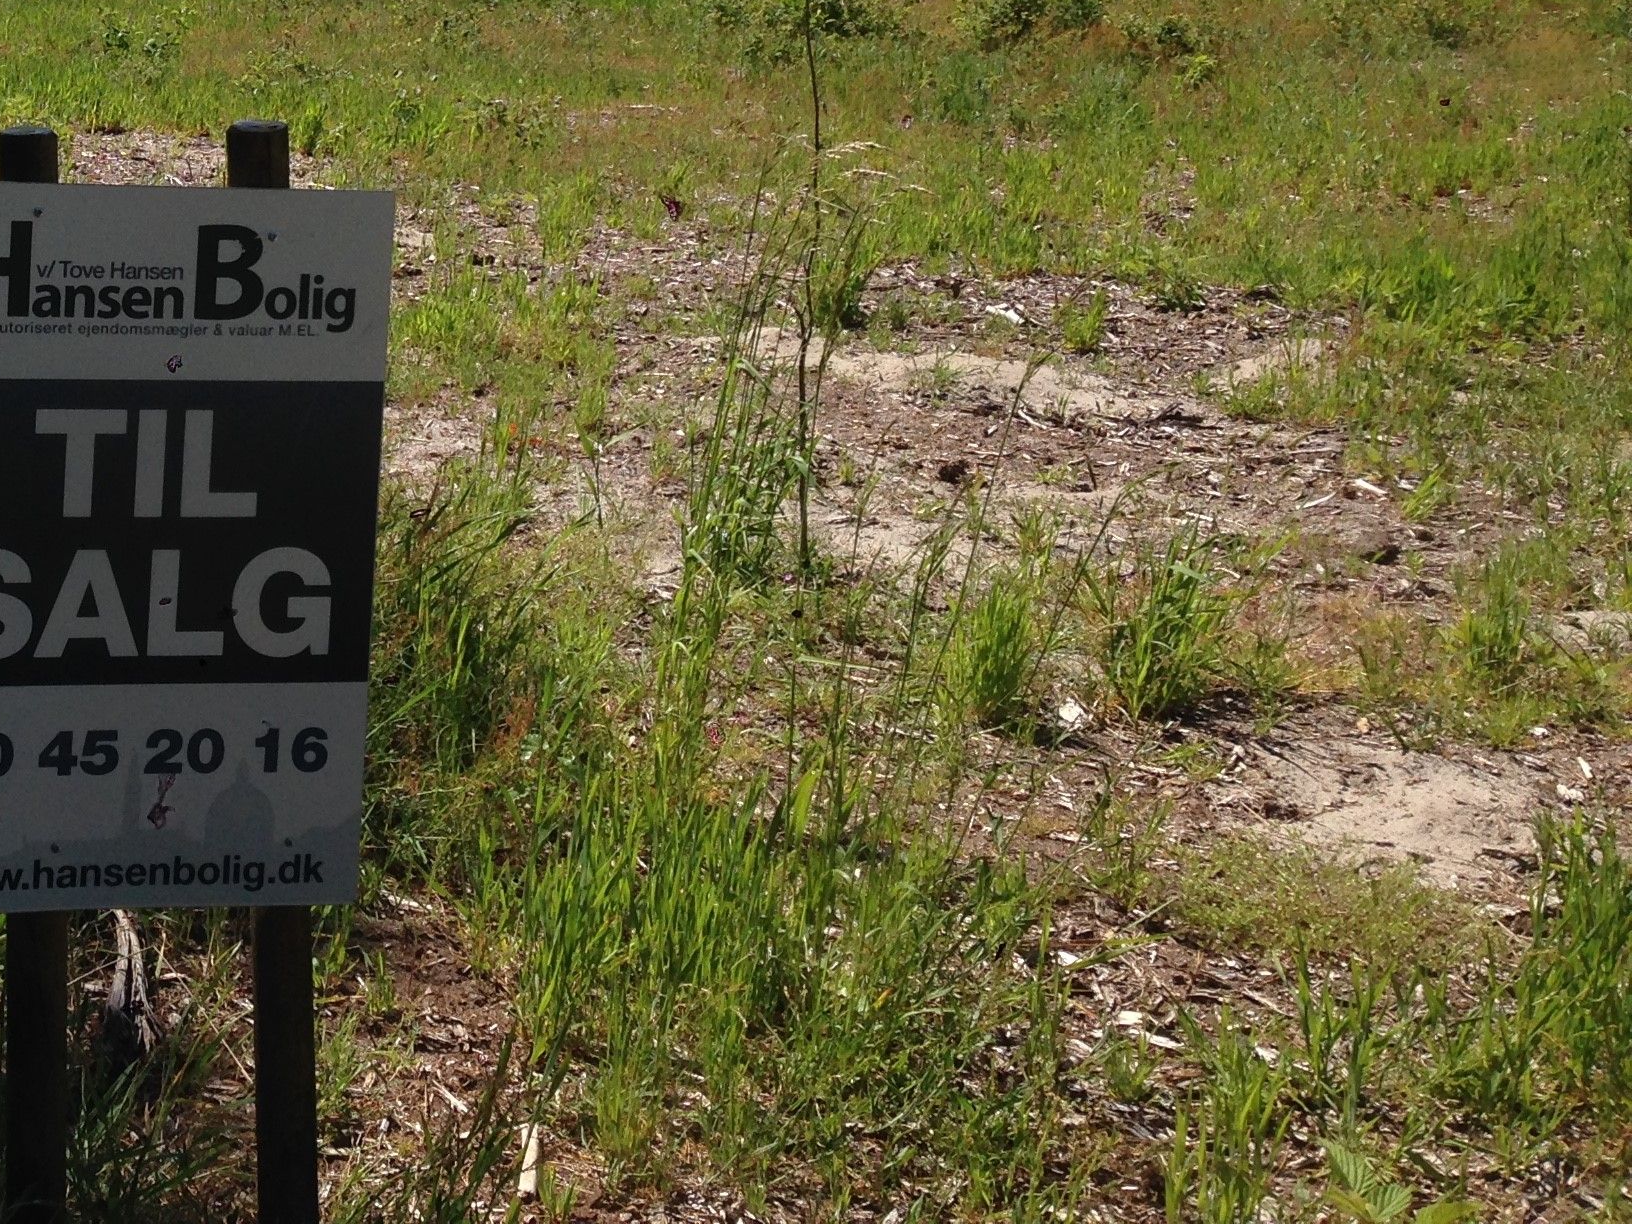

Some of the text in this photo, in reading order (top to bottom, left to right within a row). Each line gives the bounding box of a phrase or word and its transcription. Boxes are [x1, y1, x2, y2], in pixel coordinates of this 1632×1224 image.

[59, 261, 105, 279] Tove
[111, 261, 184, 280] Hansen
[194, 224, 356, 333] Bolig
[78, 321, 208, 338] ejendomsmægler
[213, 324, 224, 336] &
[229, 323, 273, 337] valuar
[35, 409, 257, 517] TIL
[38, 730, 119, 776] 45
[144, 727, 225, 775] 20
[254, 727, 329, 773] 16
